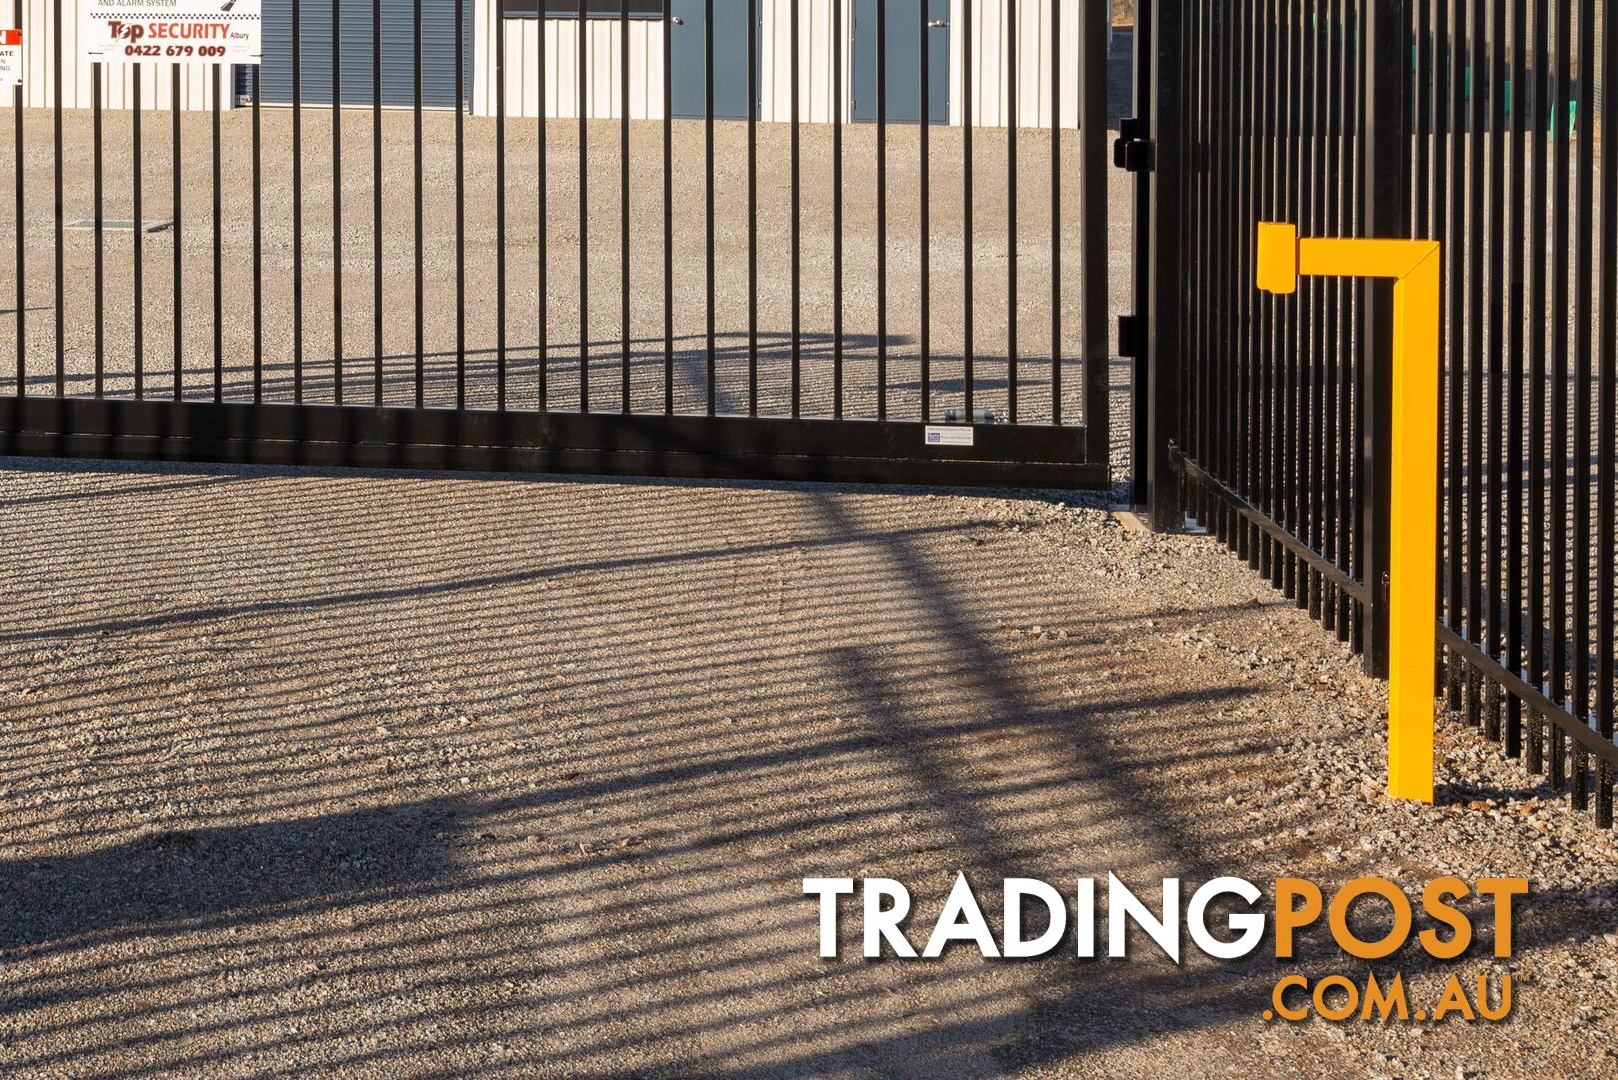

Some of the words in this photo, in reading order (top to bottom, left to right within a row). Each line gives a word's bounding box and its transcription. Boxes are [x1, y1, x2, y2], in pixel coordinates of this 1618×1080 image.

[97, 0, 115, 7] AND
[116, 0, 144, 7] ALARM
[145, 0, 177, 7] SYSTEM
[108, 21, 144, 43] Top
[148, 23, 230, 39] SECURITY
[230, 32, 250, 41] Albury
[124, 45, 161, 56] 0422
[165, 45, 194, 56] 679
[198, 46, 226, 56] 009
